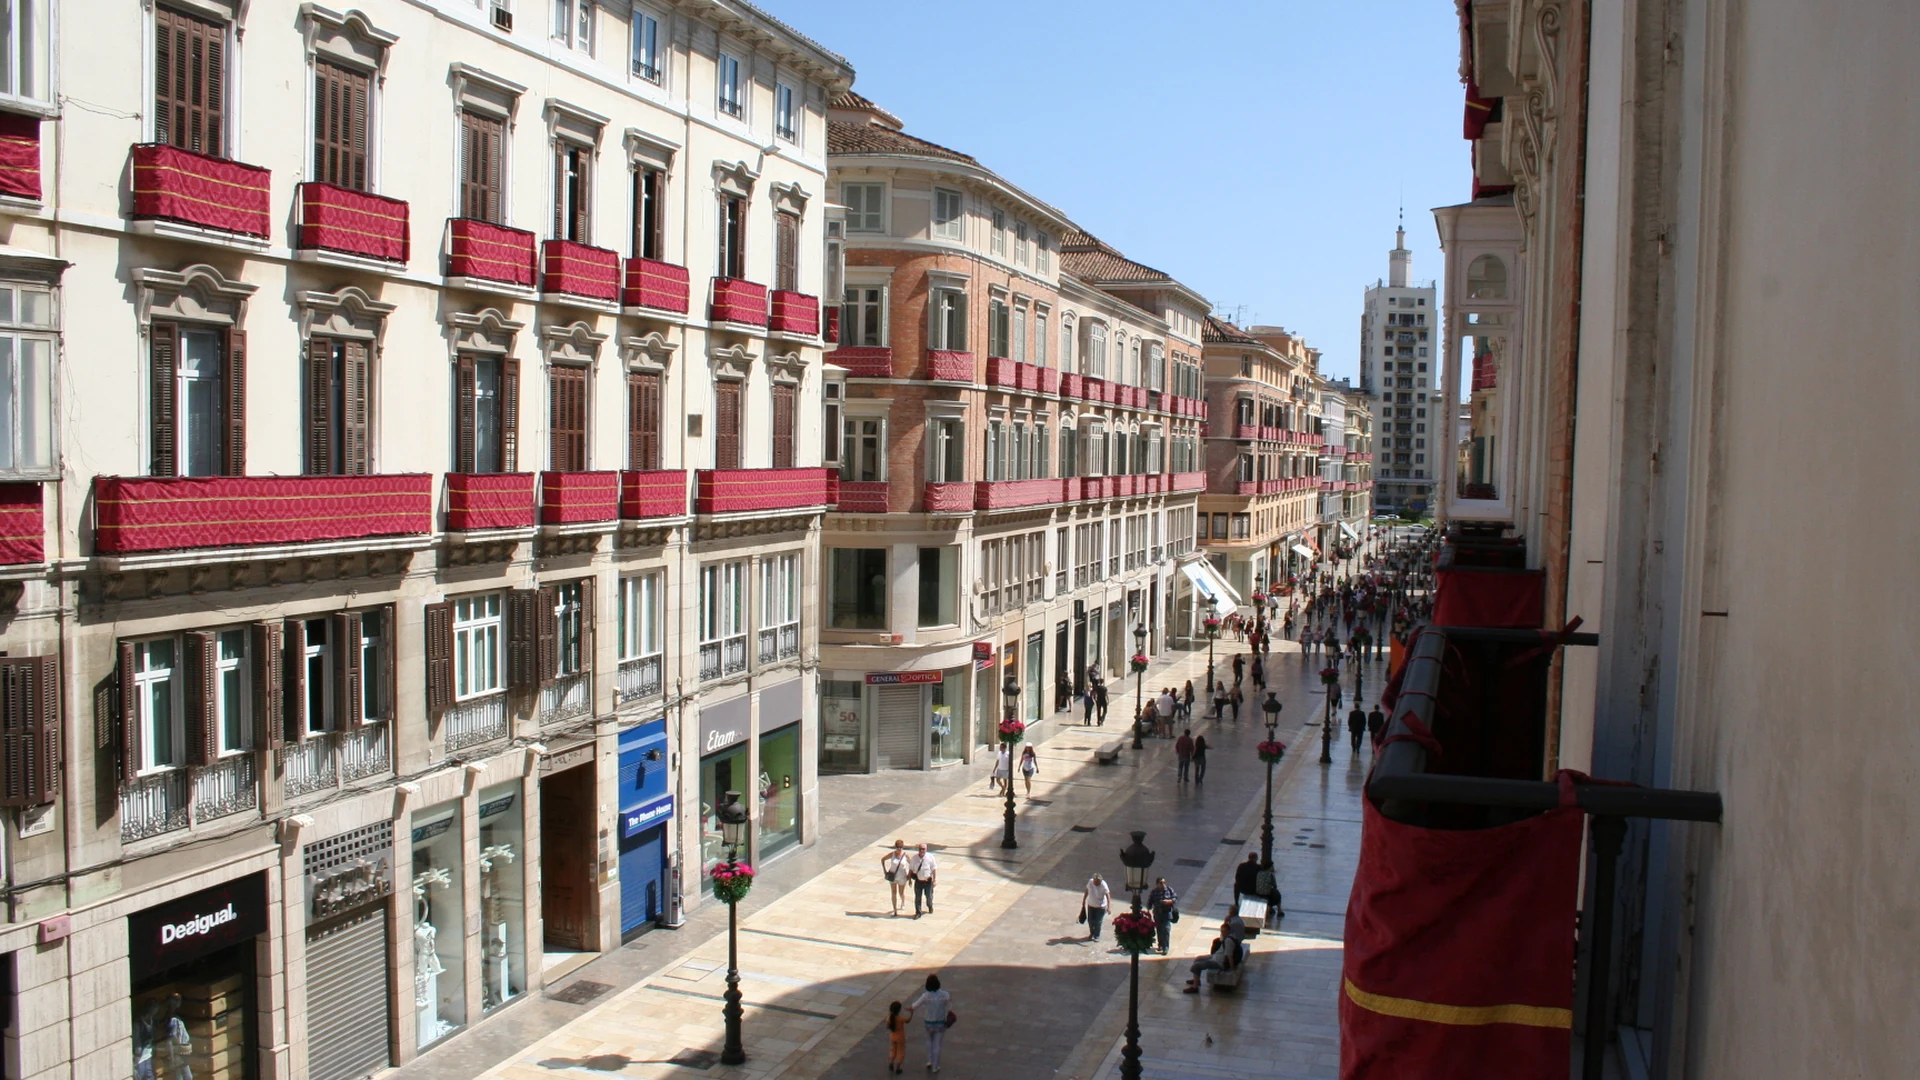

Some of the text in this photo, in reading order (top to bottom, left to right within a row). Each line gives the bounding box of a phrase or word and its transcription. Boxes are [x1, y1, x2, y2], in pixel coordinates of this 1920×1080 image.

[871, 673, 937, 683] GENERAL OPTICA
[706, 729, 735, 752] Etam
[628, 803, 672, 827] The Phone House
[161, 902, 234, 945] Desigual
